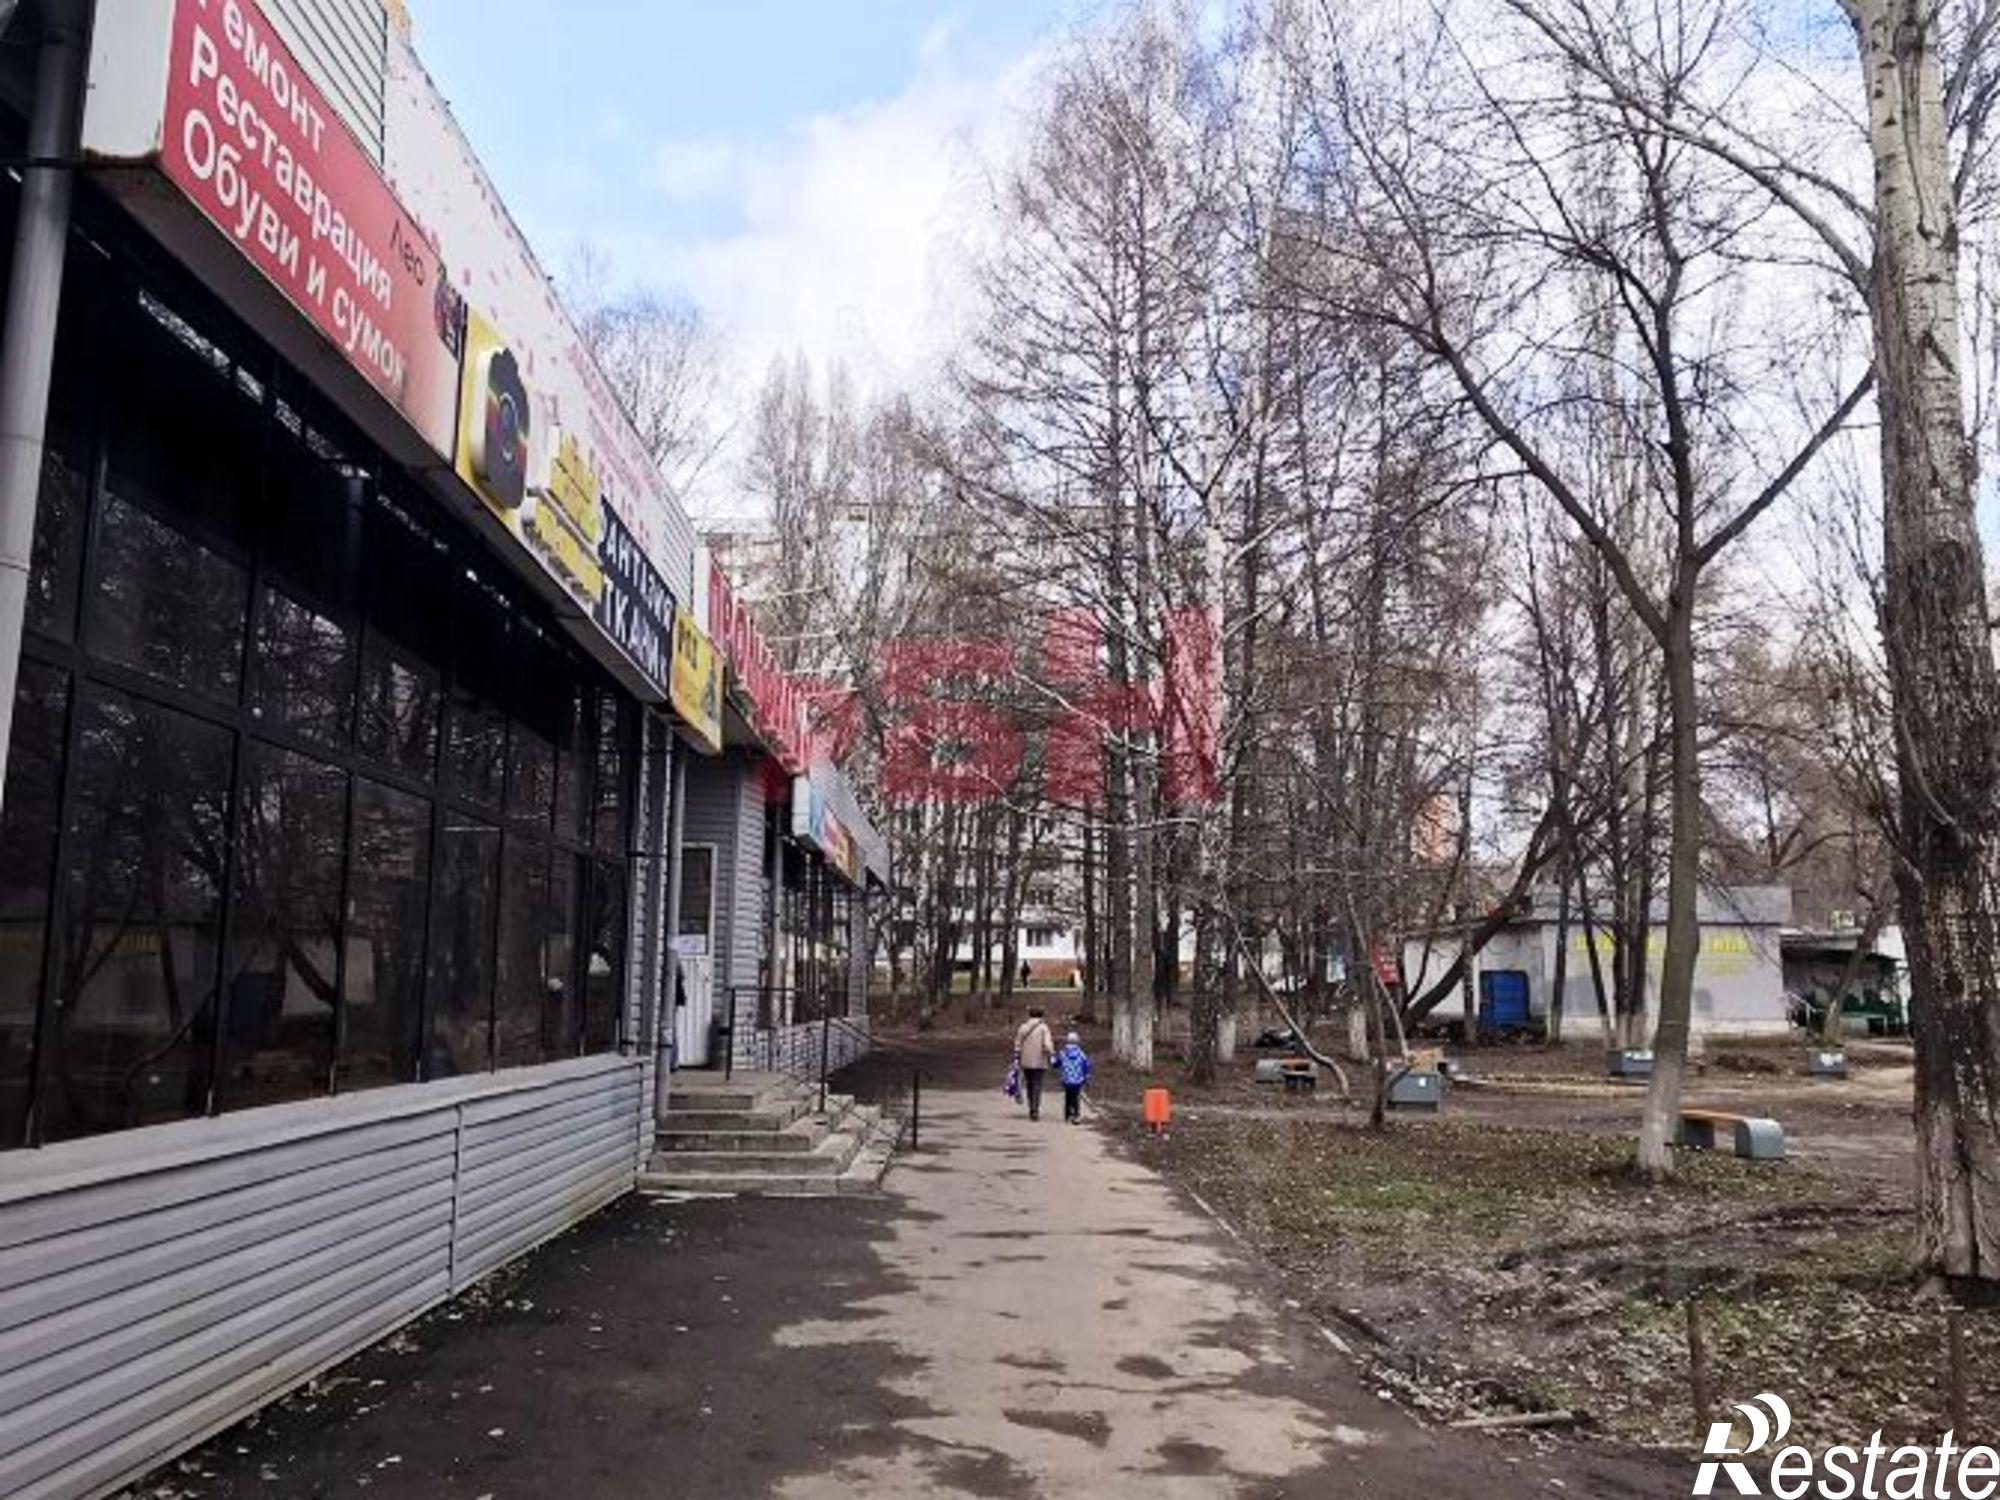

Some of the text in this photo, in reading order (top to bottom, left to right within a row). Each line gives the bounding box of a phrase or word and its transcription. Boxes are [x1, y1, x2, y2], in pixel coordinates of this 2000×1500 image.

[189, 24, 392, 311] Реставрация
[200, 0, 326, 153] емонт
[183, 109, 299, 278] Обуви
[306, 255, 326, 307] и
